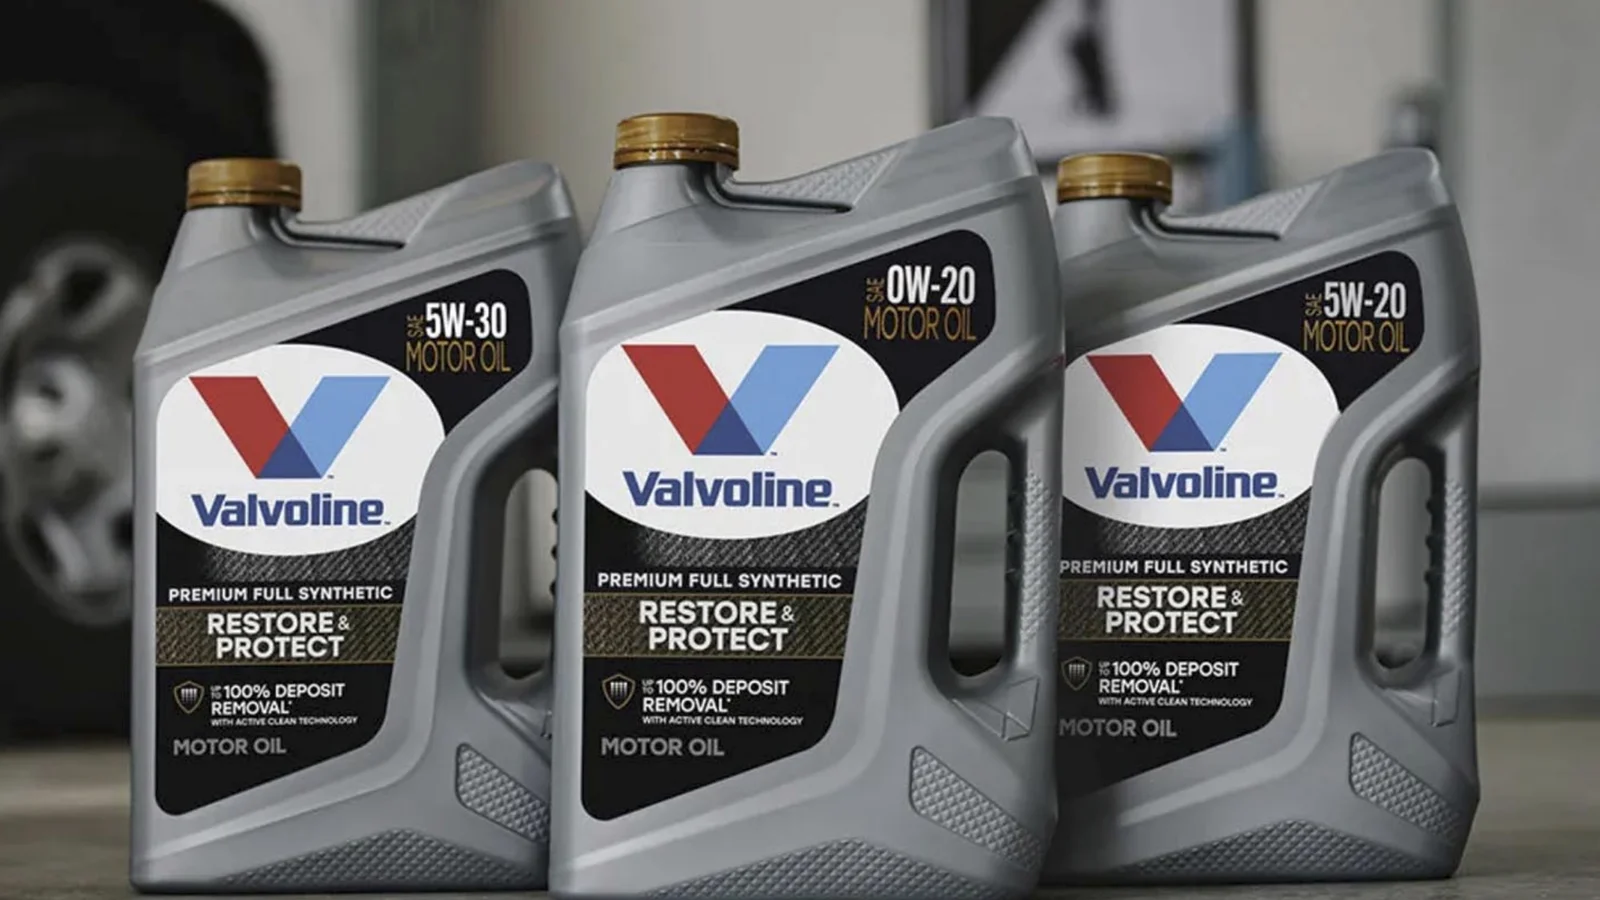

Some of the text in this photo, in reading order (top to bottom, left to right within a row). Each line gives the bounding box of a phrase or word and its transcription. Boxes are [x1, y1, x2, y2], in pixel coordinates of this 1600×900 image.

[886, 264, 976, 306] 0W-20
[1323, 281, 1407, 319] 5W-20
[425, 302, 508, 339] 5W-30
[863, 305, 977, 341] MOTOR OIL
[1303, 319, 1411, 354] MOTOR OIL
[405, 339, 512, 373] MOTOR OIL
[622, 470, 833, 507] Valvoline
[1085, 465, 1278, 500] Valvoline
[191, 492, 385, 527] Valvoline
[1059, 560, 1289, 574] PREMIUM FULL SYNTHETIC
[597, 573, 842, 589] PREMIUM FULL SYNTHETIC
[168, 585, 393, 602] PREMIUM FULL SYNTHETIC
[1097, 585, 1245, 609] RESTORE &
[207, 612, 350, 635] RESTORE &
[639, 600, 796, 625] RESTORE &
[1105, 610, 1238, 634] PROTECT
[216, 635, 345, 659] PROTECT
[649, 626, 789, 651] PROTECT
[1112, 661, 1240, 678] 100% DEPOSIT
[223, 683, 346, 699] 100% DEPOSIT
[656, 679, 790, 696] 100% DEPOSIT
[1098, 697, 1253, 707] WITH ACTIVE CLEAN TECHNOLOGY
[211, 716, 358, 727] WITH ACTIVE CLEAN TECHNOLOGY
[642, 715, 803, 726] WITH ACTIVE CLEAN TECHNOLOGY
[1059, 718, 1177, 737] MOTOR OIL
[173, 738, 287, 756] MOTOR OIL
[601, 737, 725, 757] MOTOR OIL
